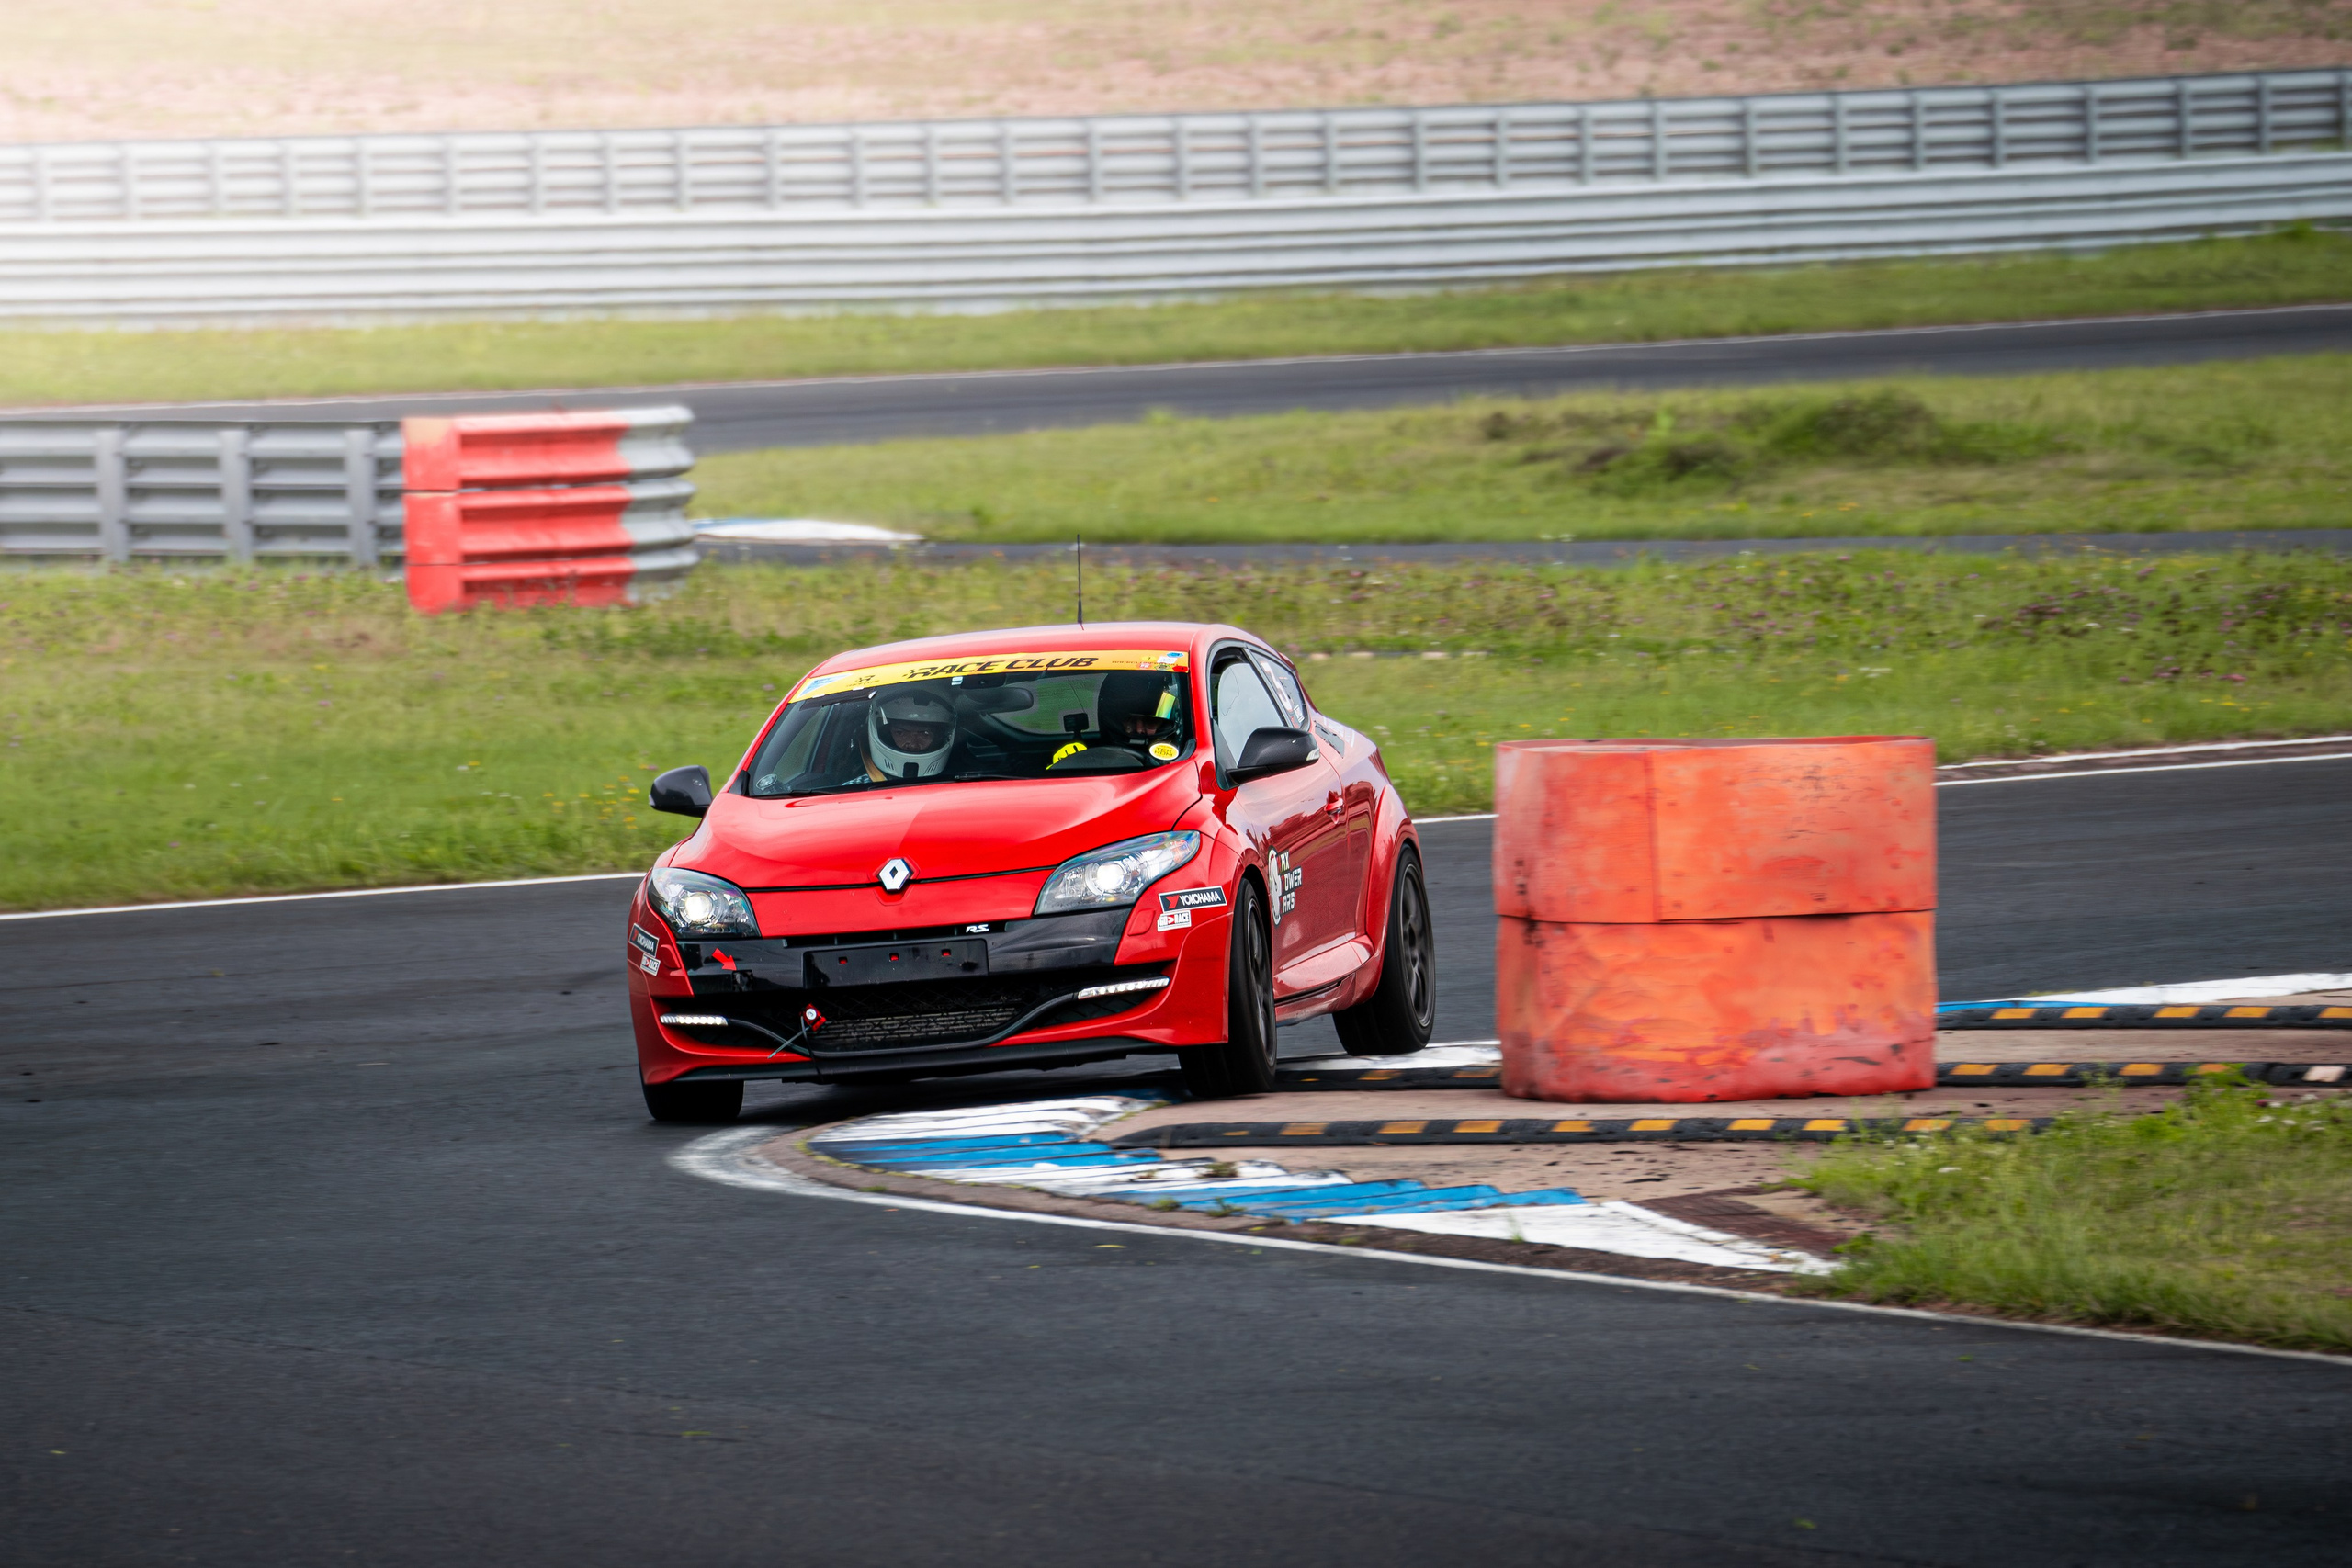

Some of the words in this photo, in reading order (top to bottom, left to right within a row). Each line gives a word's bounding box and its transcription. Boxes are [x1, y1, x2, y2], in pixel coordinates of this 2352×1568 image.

[904, 660, 1004, 679] RACE
[1006, 657, 1098, 671] CLUB
[1180, 891, 1221, 906] YOKOHAMA
[966, 923, 989, 933] RS
